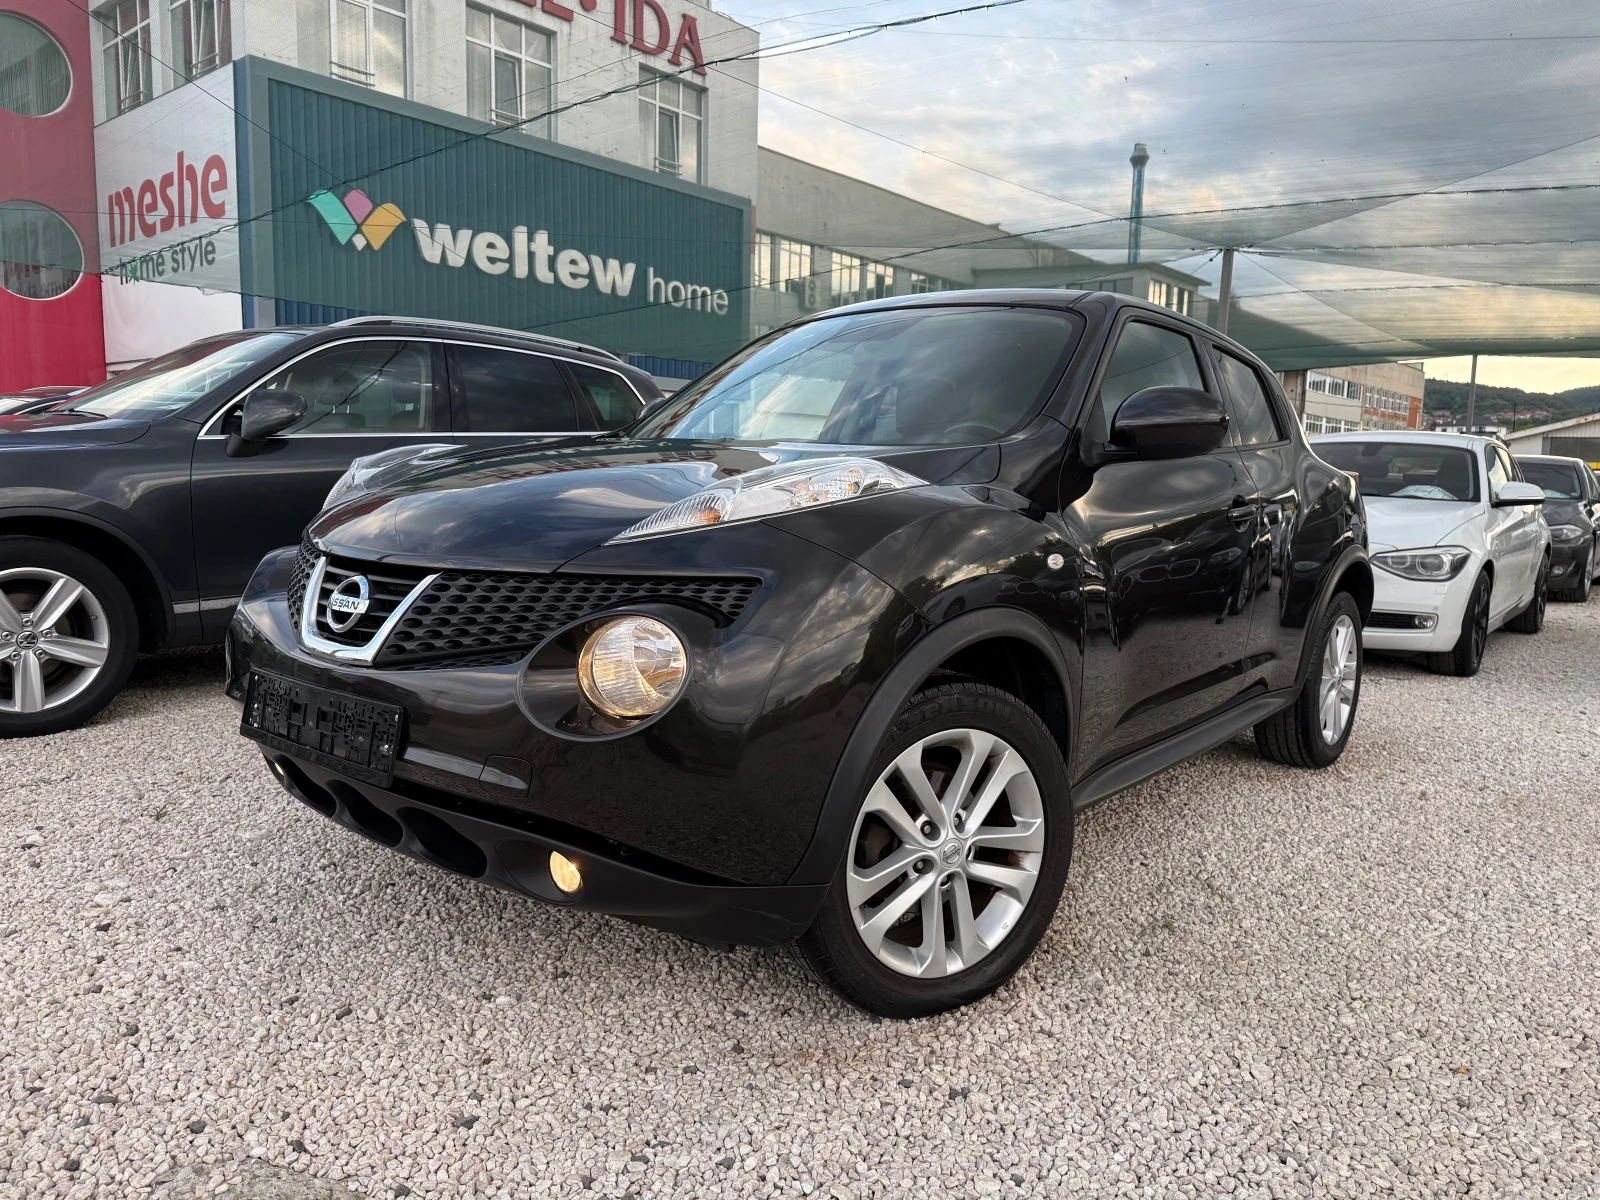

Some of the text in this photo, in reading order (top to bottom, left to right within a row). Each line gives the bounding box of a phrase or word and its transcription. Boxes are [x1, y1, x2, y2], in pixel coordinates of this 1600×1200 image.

[610, 0, 707, 76] IDA
[108, 150, 228, 248] meshe
[171, 238, 216, 273] style
[411, 217, 729, 315] weltew home
